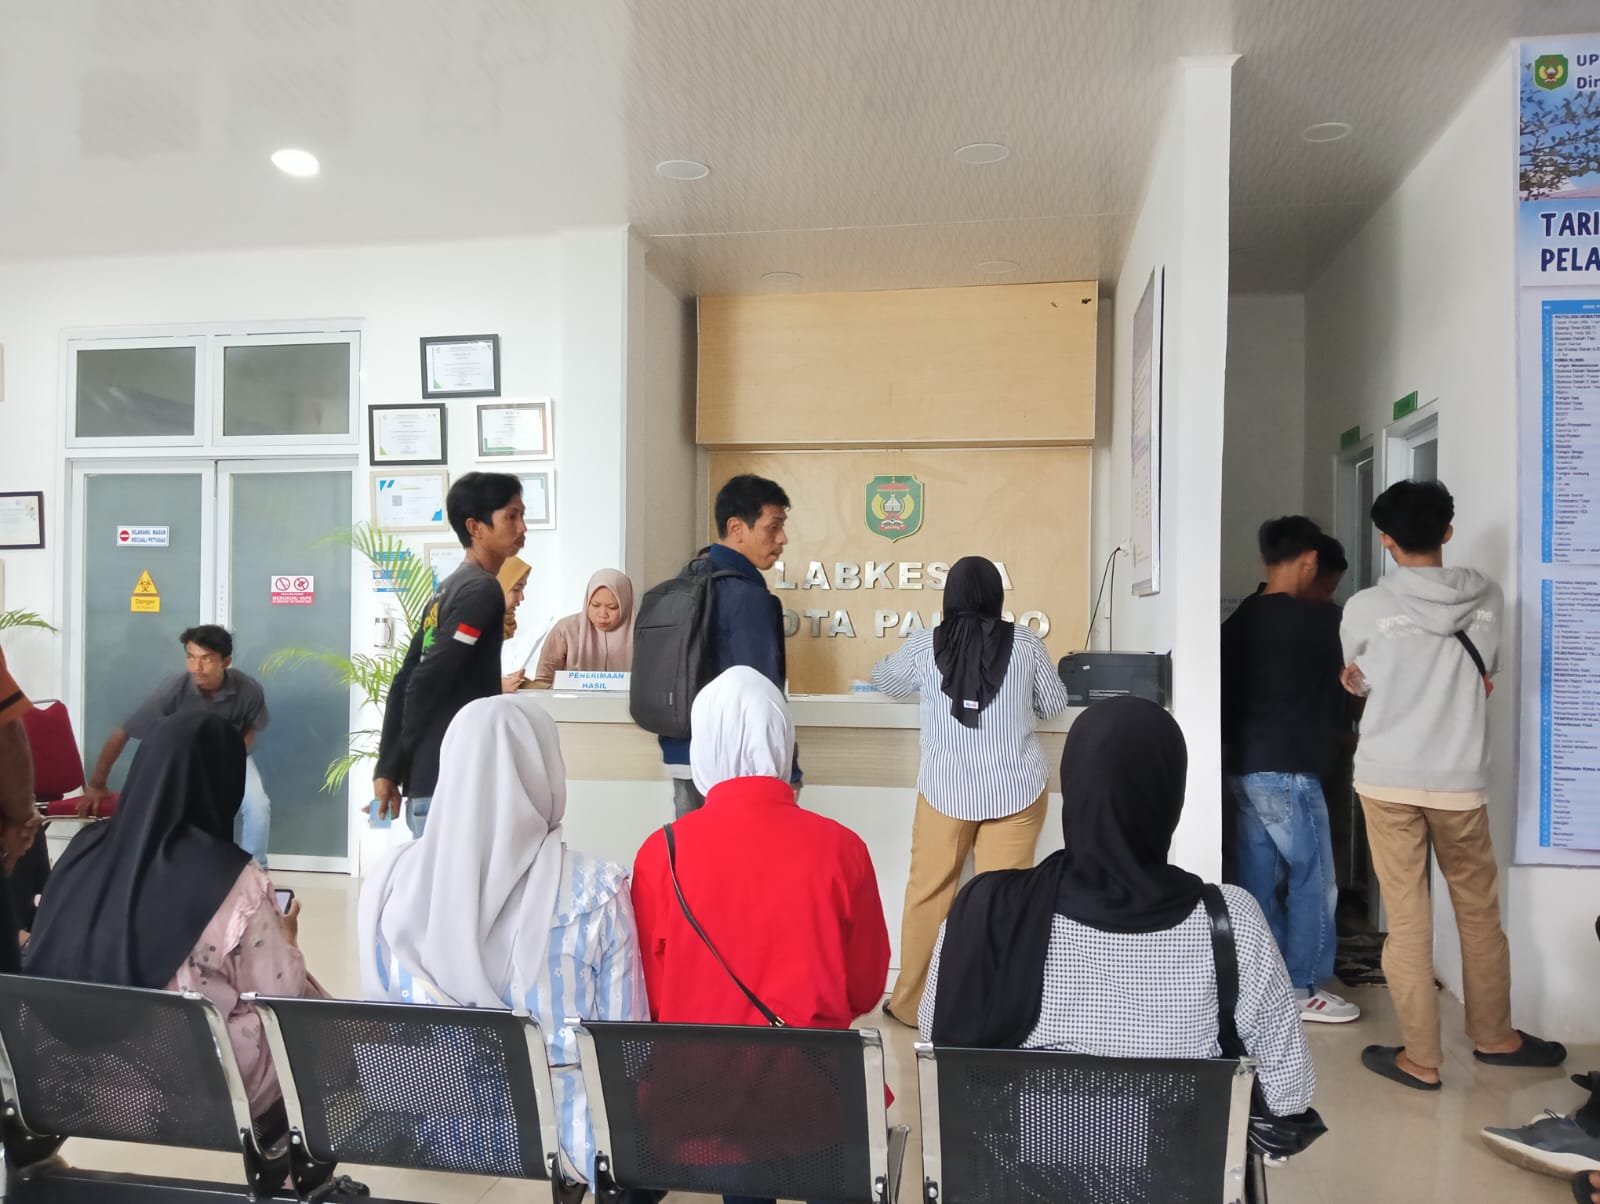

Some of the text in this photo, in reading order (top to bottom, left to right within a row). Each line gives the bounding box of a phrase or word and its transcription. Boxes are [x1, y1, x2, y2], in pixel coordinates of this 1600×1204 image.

[1540, 211, 1600, 237] TARI
[1541, 246, 1600, 272] PELA
[774, 560, 1014, 591] LABKESA
[783, 608, 856, 638] OTA
